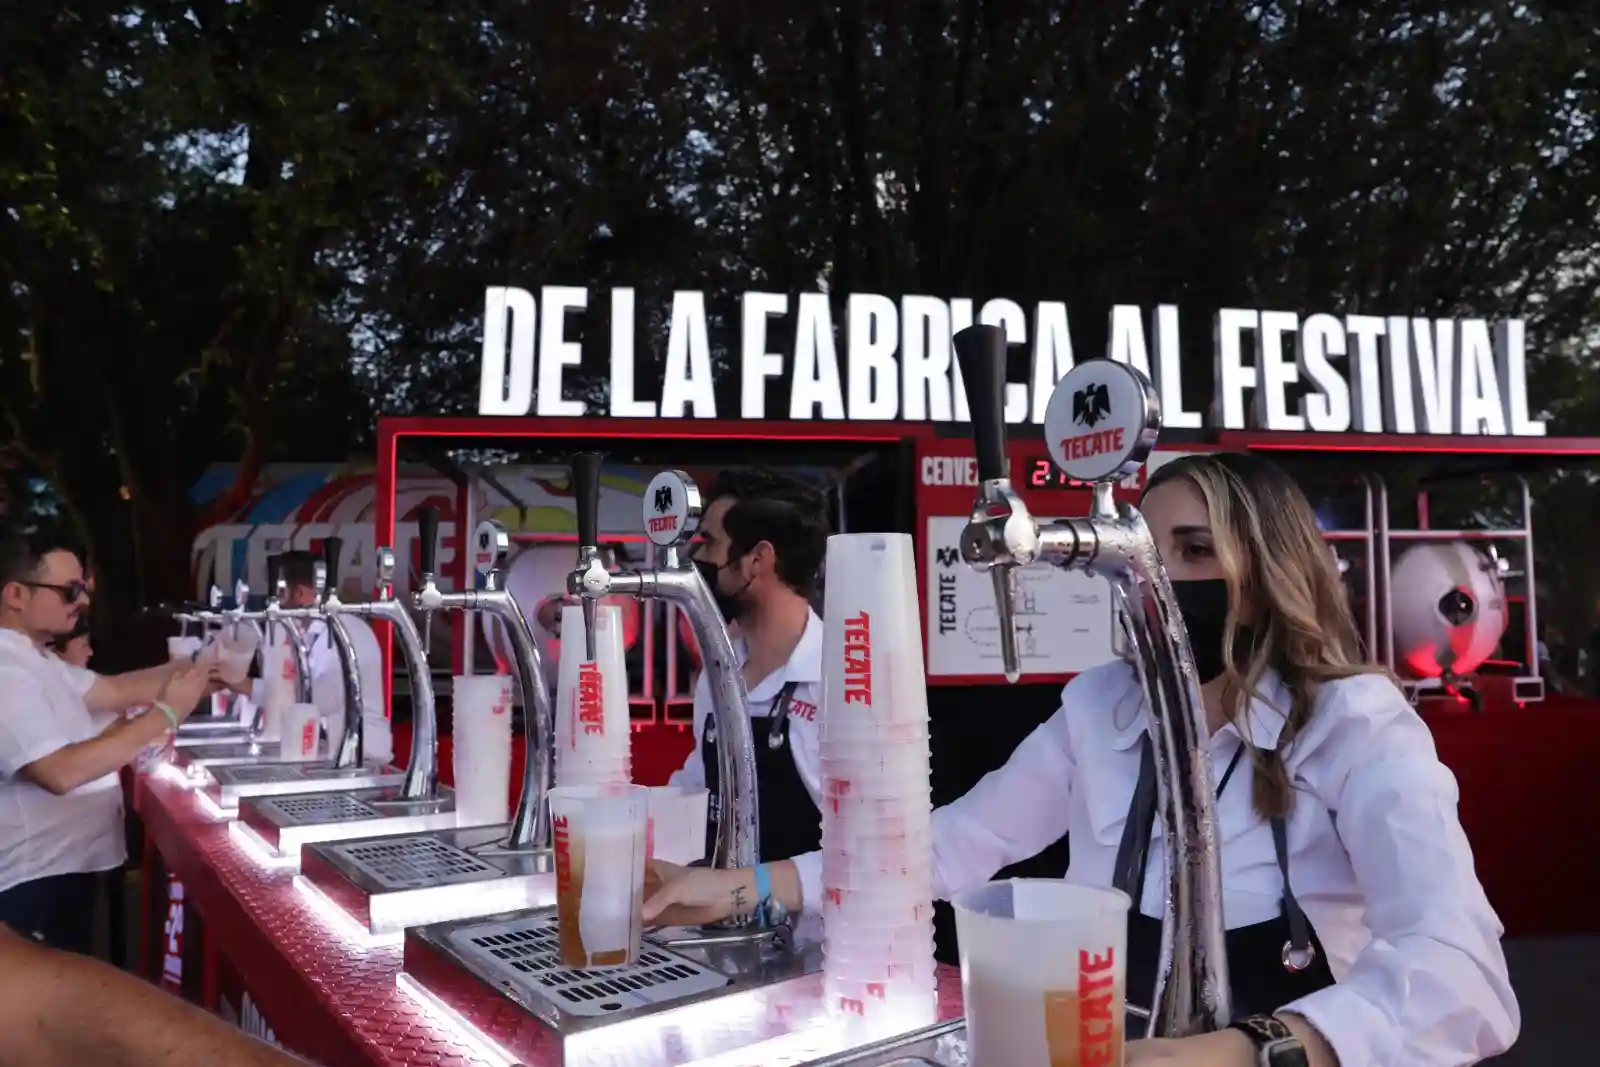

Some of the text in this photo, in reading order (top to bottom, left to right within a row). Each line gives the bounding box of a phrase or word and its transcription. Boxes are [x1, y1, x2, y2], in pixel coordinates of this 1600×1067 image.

[478, 286, 588, 416] DE
[610, 287, 717, 419] LA
[1215, 308, 1547, 436] FESTIVAL
[1060, 427, 1125, 461] TECATE
[939, 573, 956, 635] TECATE
[844, 611, 872, 708] TECATE
[1078, 947, 1113, 1067] ECATE
